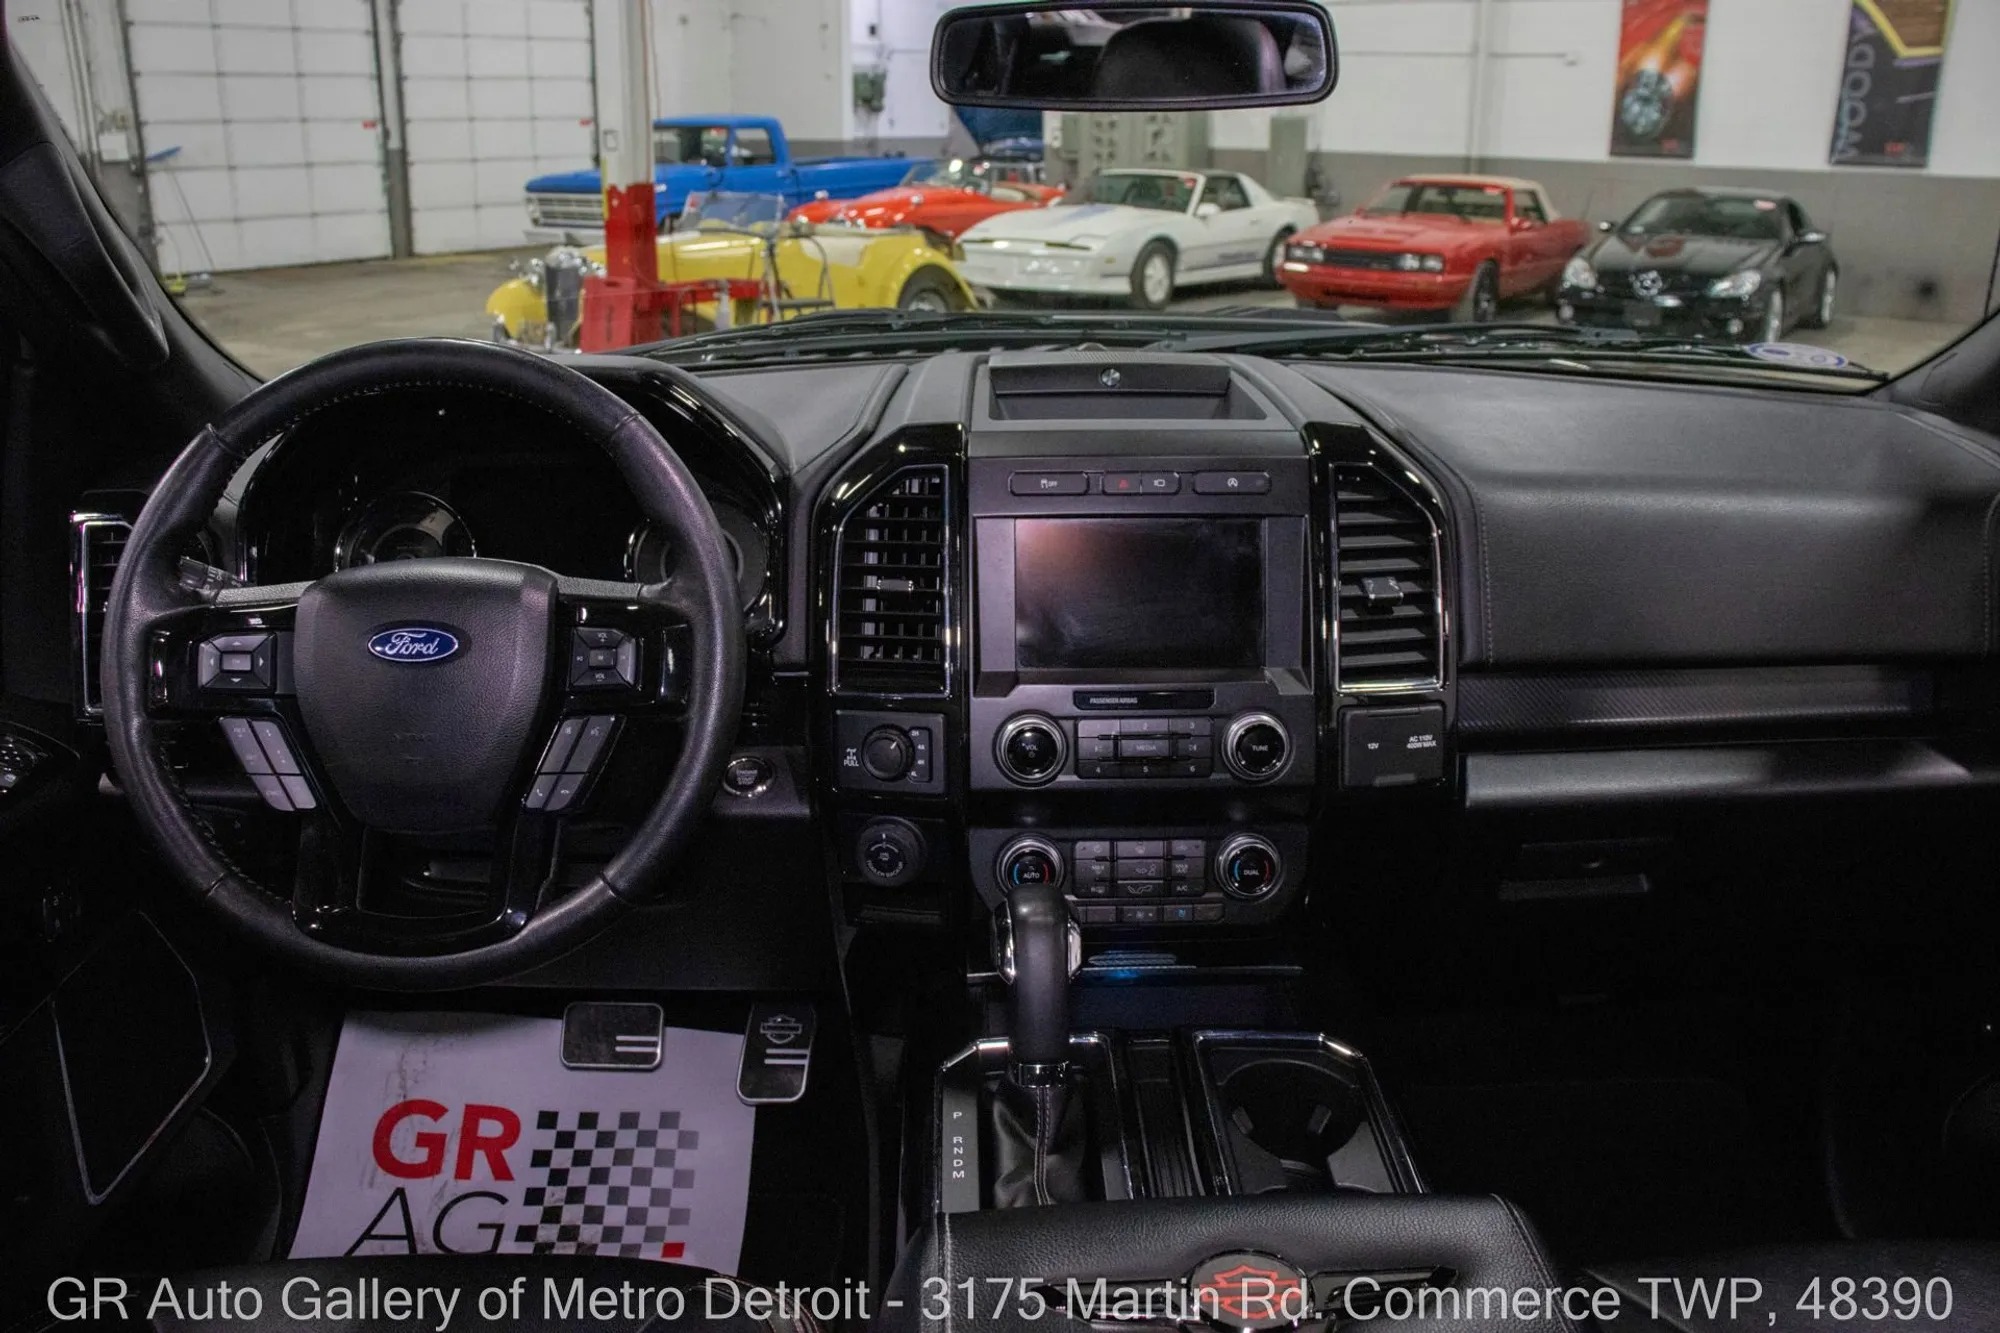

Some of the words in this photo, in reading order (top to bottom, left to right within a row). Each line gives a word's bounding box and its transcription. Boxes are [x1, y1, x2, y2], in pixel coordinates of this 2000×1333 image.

[385, 632, 440, 655] Ford
[1367, 742, 1380, 750] 12V
[1423, 740, 1437, 748] MAX
[953, 1111, 963, 1119] P
[372, 1098, 521, 1181] GR
[953, 1147, 963, 1155] N
[953, 1159, 963, 1167] D
[952, 1170, 965, 1179] M
[343, 1187, 509, 1255] AG
